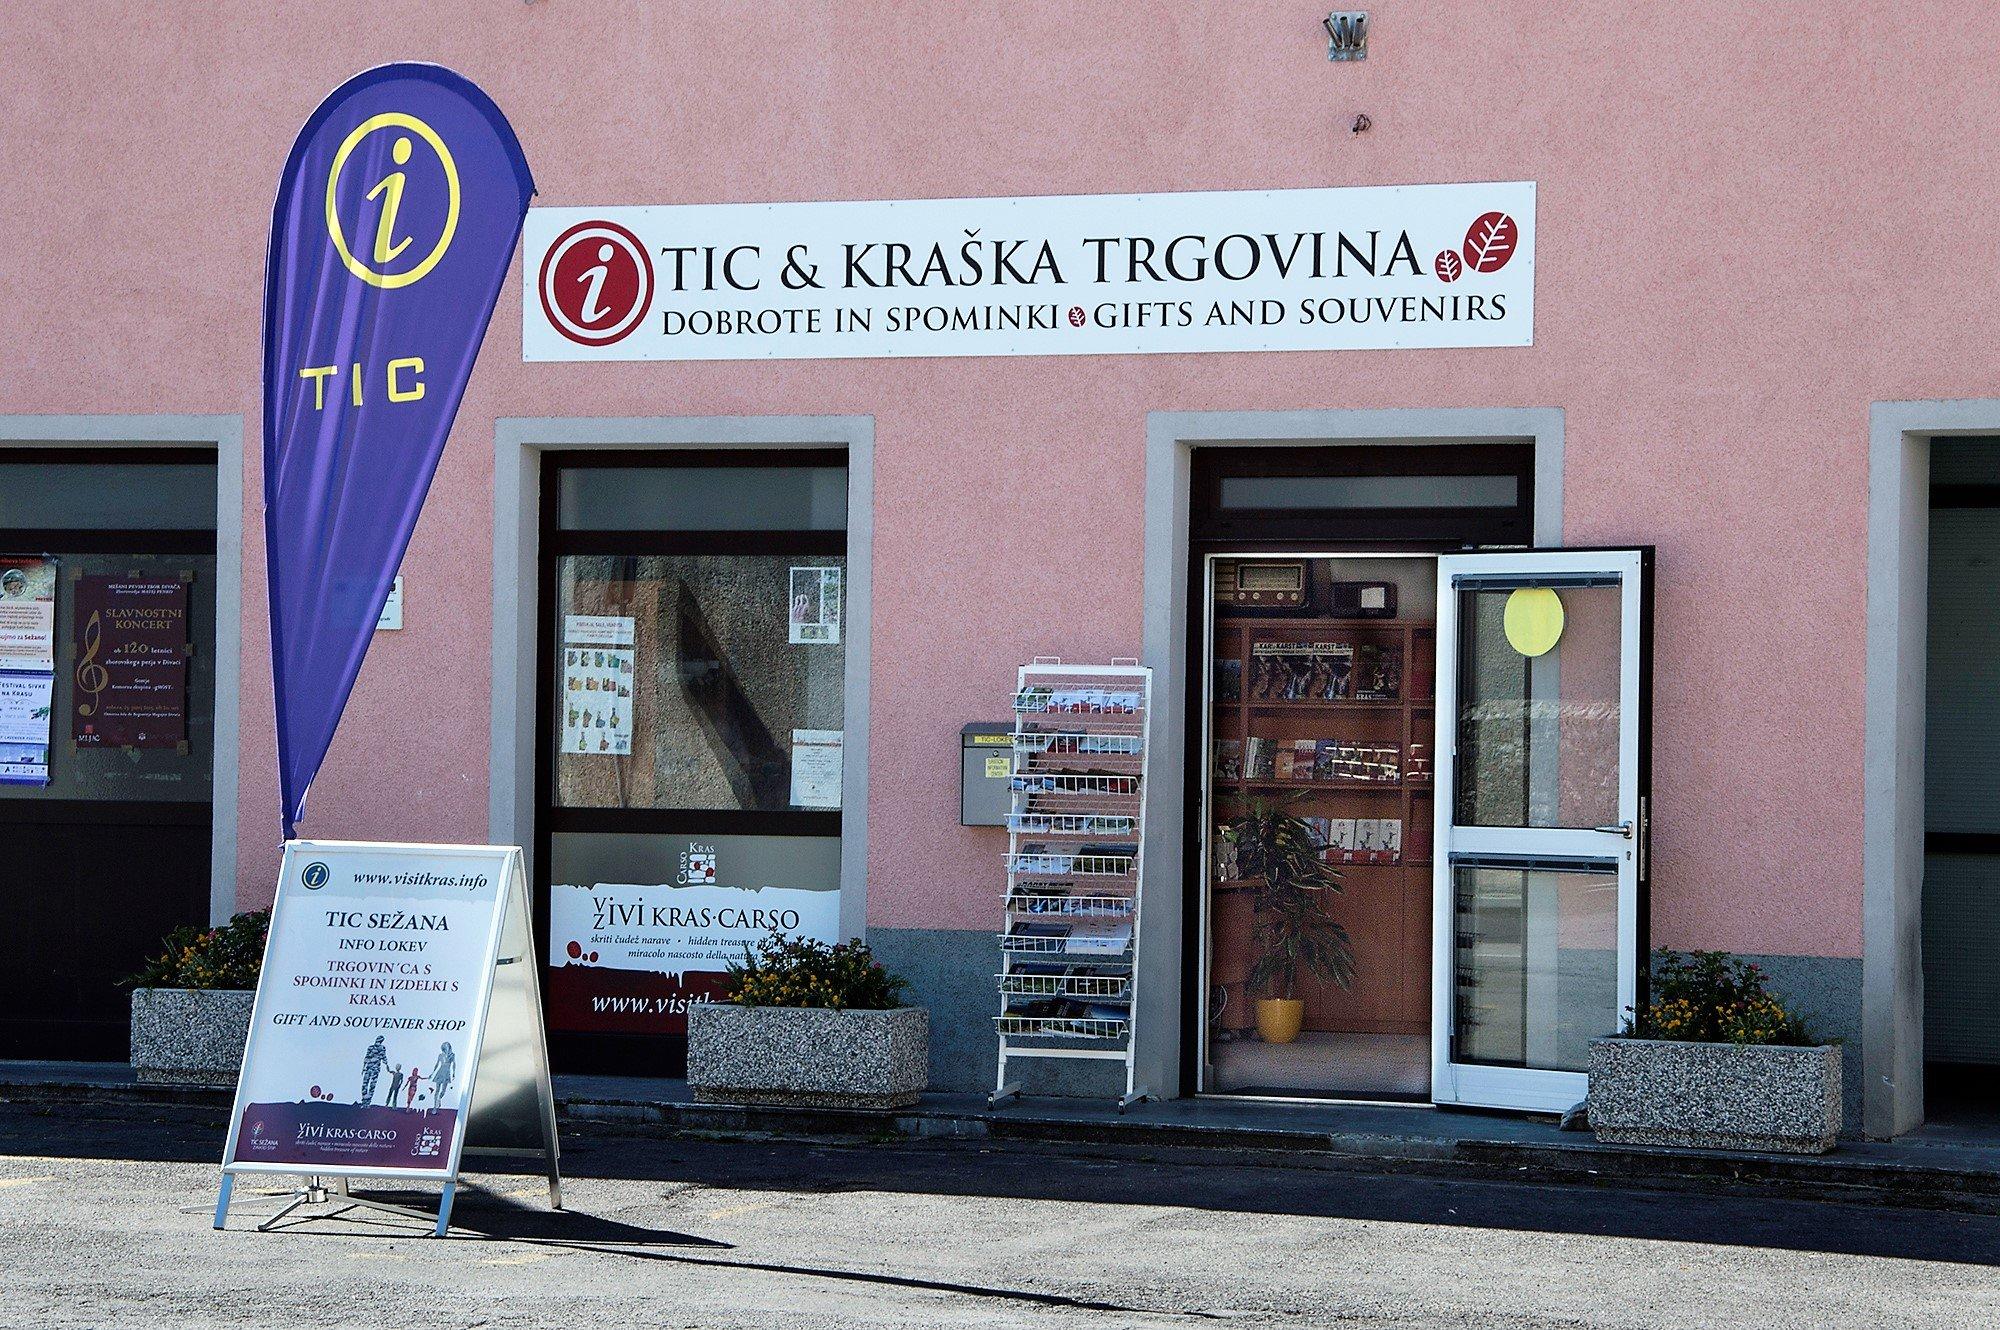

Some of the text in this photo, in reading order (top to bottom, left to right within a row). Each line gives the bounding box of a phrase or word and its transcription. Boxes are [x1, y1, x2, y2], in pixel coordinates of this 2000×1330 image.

[661, 228, 1427, 291] TIC & KRAŠKA TRGOVINA
[662, 293, 1507, 336] DOBROTE IN SPOMINKI GIFTS AND SOUVENIRS
[299, 356, 426, 411] TIC
[106, 608, 183, 619] SLAVNOSTNI
[115, 619, 173, 629] KONCERT
[124, 641, 149, 654] 120
[353, 871, 488, 891] www.visitkras.info
[325, 910, 450, 931] TIC SEŽANA
[339, 938, 428, 952] INFO LOKEV
[590, 934, 613, 945] skriti
[615, 934, 640, 946] čudež
[641, 937, 671, 946] narave
[688, 936, 718, 947] hidden
[628, 948, 665, 960] miracolo
[667, 950, 704, 960] nascosto
[706, 949, 727, 960] della
[423, 963, 432, 975] S
[293, 975, 459, 992] SPOMINKI IN IZDELKI S
[348, 993, 397, 1006] KRASA
[273, 1013, 466, 1032] GIFT AND SOUVENIER SHOP
